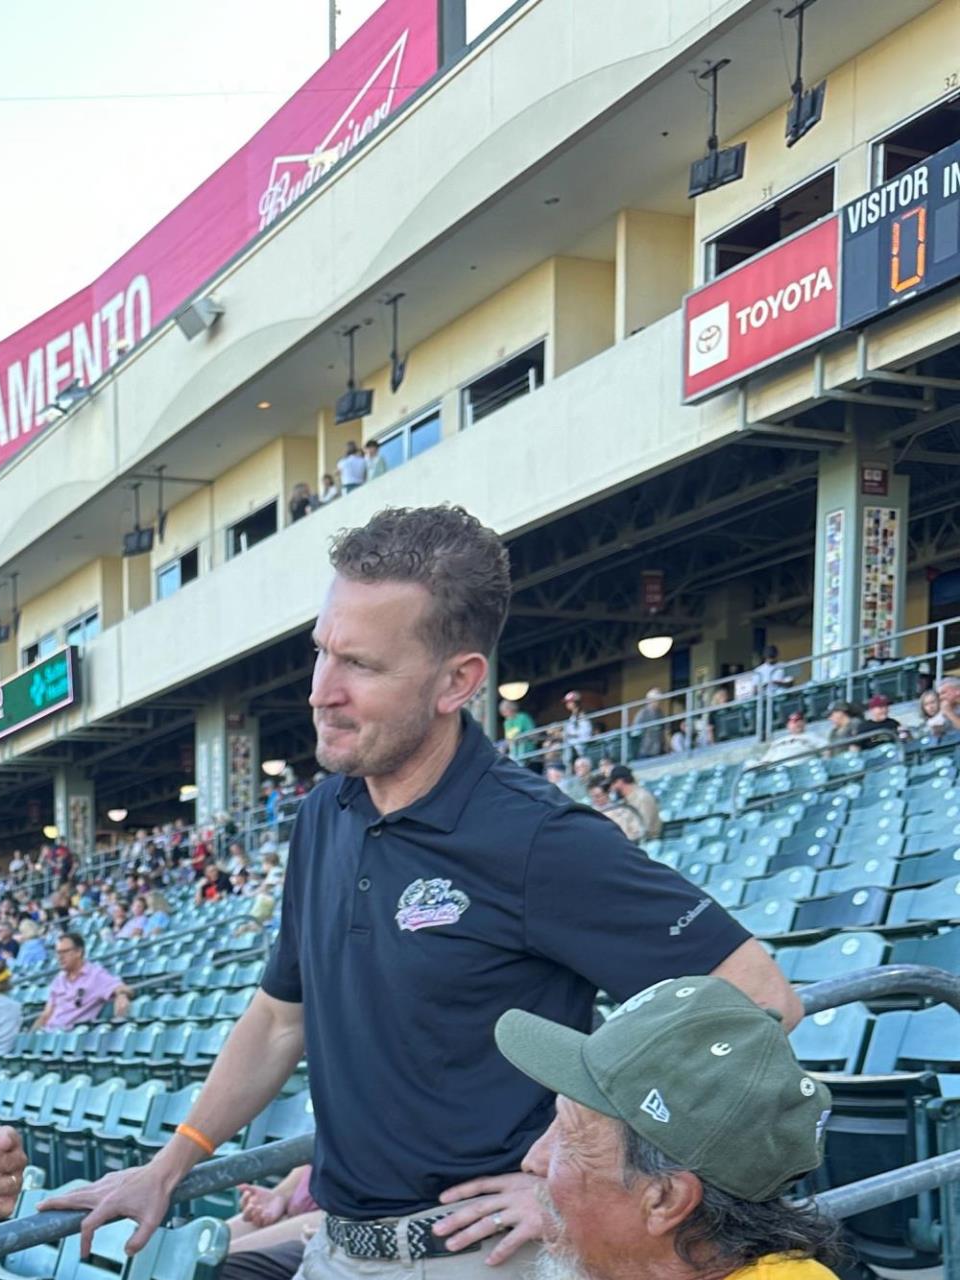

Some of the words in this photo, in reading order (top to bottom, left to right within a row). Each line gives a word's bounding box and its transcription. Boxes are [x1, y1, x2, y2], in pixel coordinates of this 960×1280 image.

[847, 165, 929, 235] VISITOR
[890, 205, 926, 294] 0
[735, 266, 834, 336] TOYOTA
